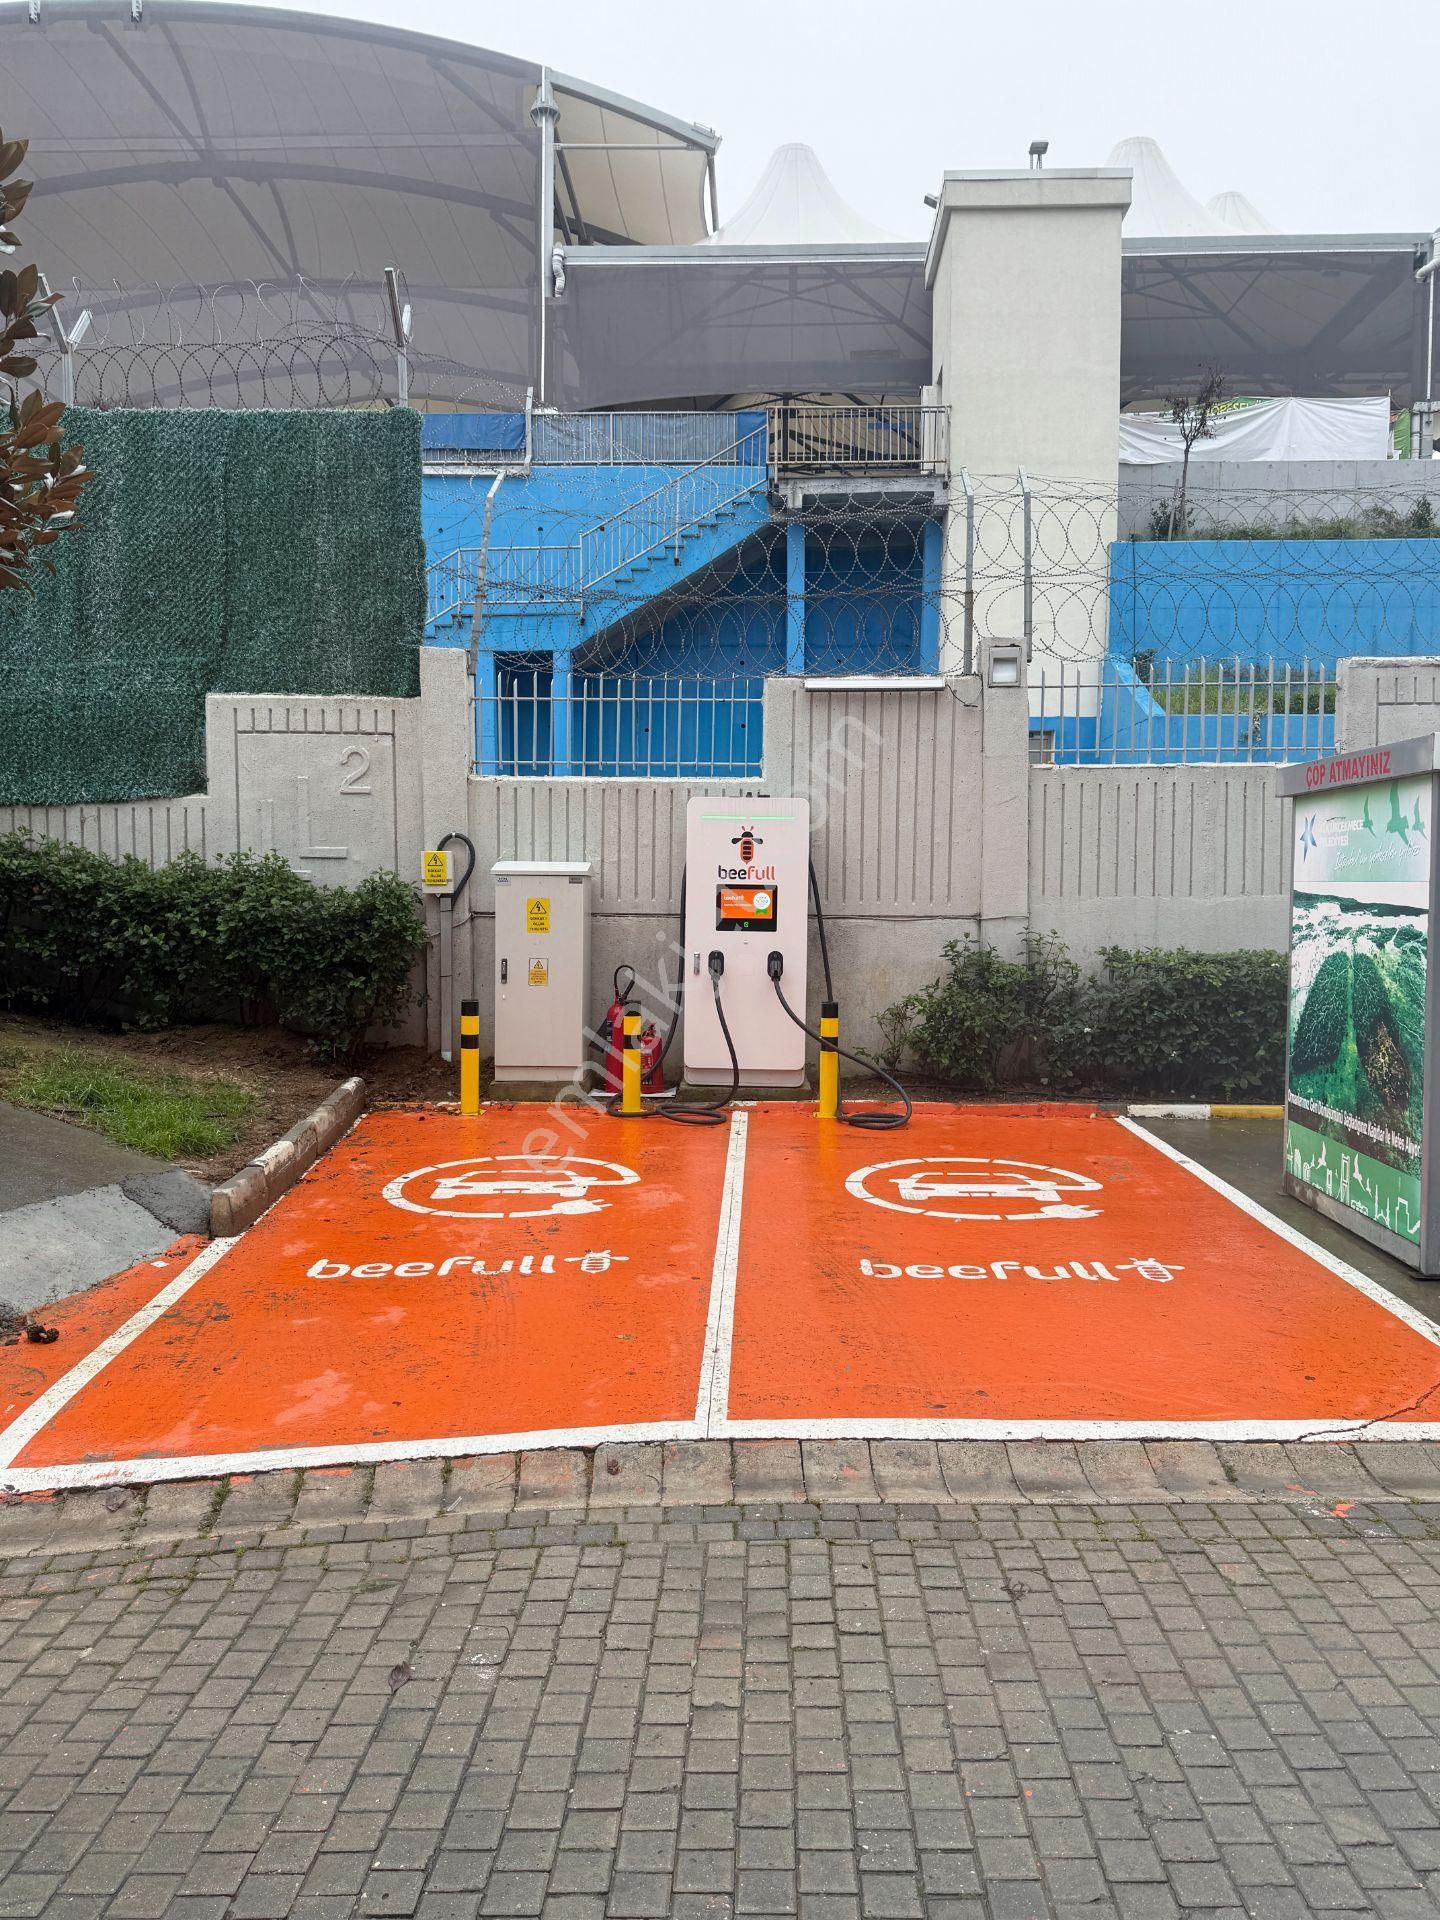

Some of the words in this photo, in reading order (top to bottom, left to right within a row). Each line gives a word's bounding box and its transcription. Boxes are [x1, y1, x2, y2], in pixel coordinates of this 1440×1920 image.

[1306, 762, 1326, 790] ÇÖP
[1329, 751, 1392, 783] ATMAYINIZ
[718, 864, 775, 880] beefull
[306, 1256, 555, 1279] beefull
[858, 1259, 1120, 1281] beefull
